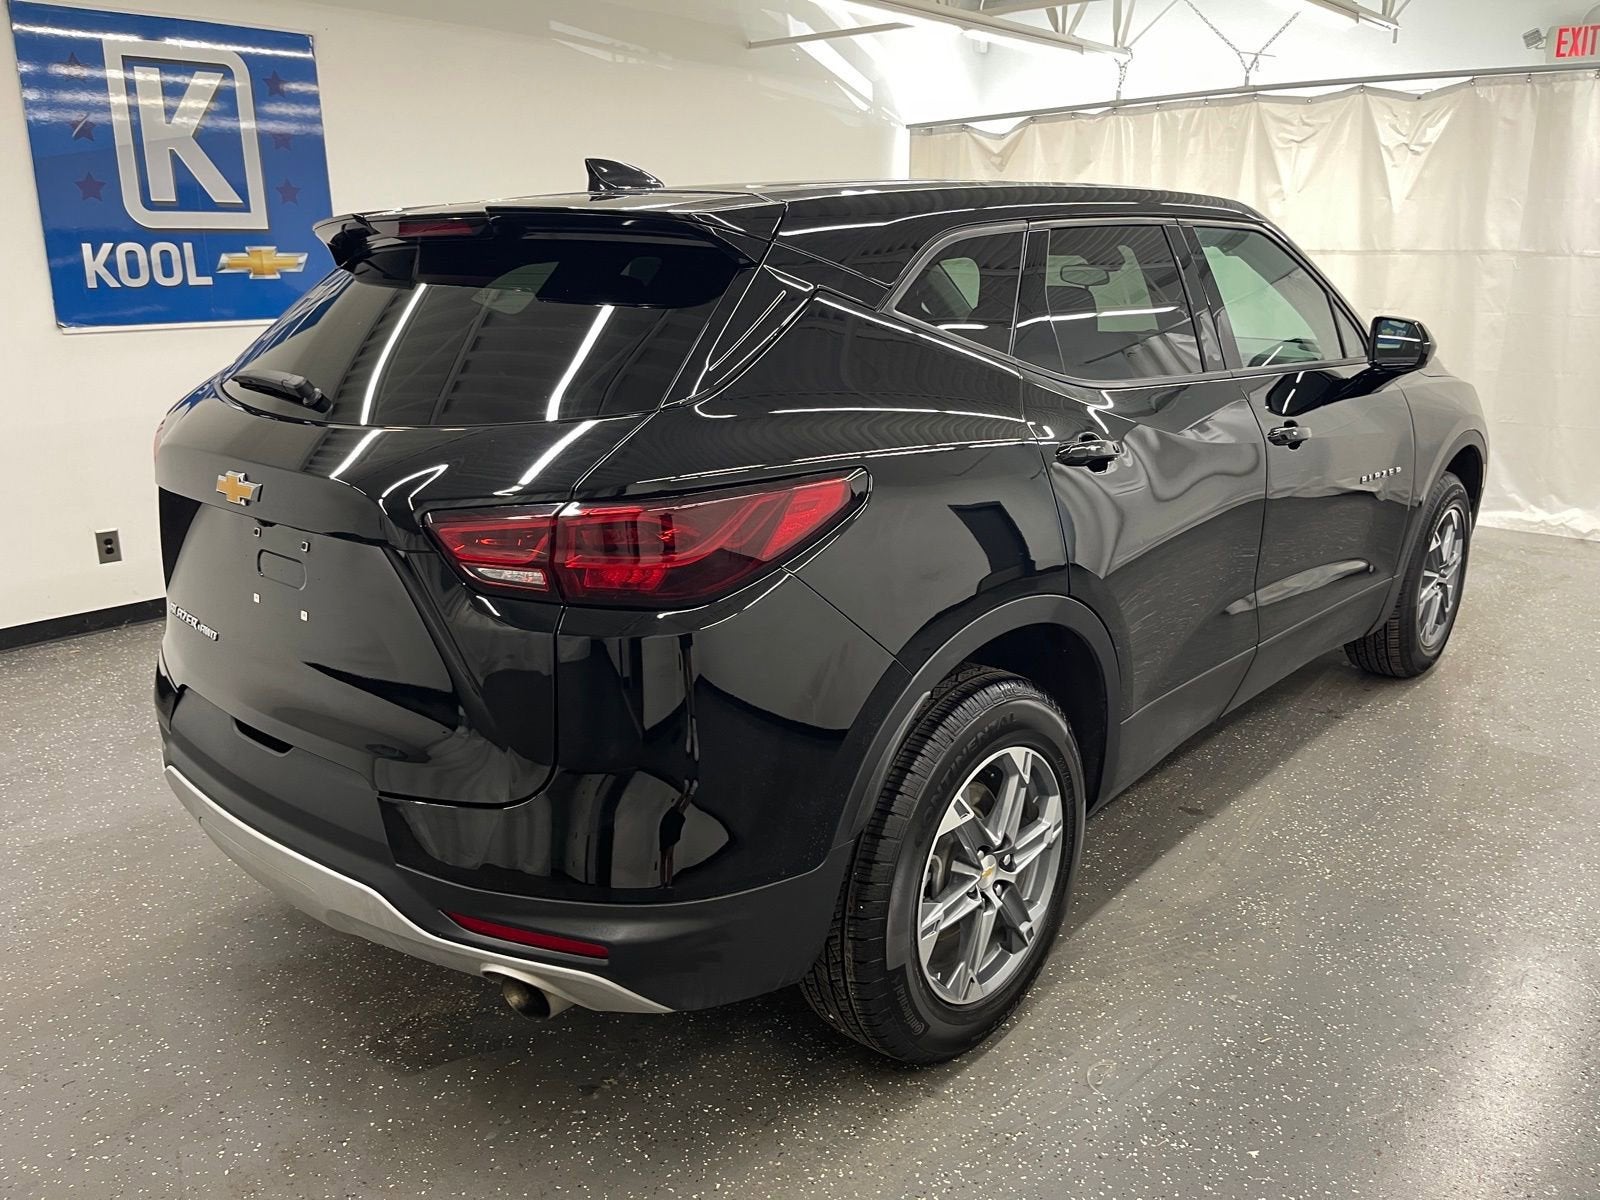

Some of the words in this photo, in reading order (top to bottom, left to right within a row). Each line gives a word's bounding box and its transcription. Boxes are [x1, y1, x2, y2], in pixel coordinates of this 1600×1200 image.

[1556, 25, 1600, 57] EXIT
[133, 66, 243, 203] K
[81, 241, 213, 289] KOOL
